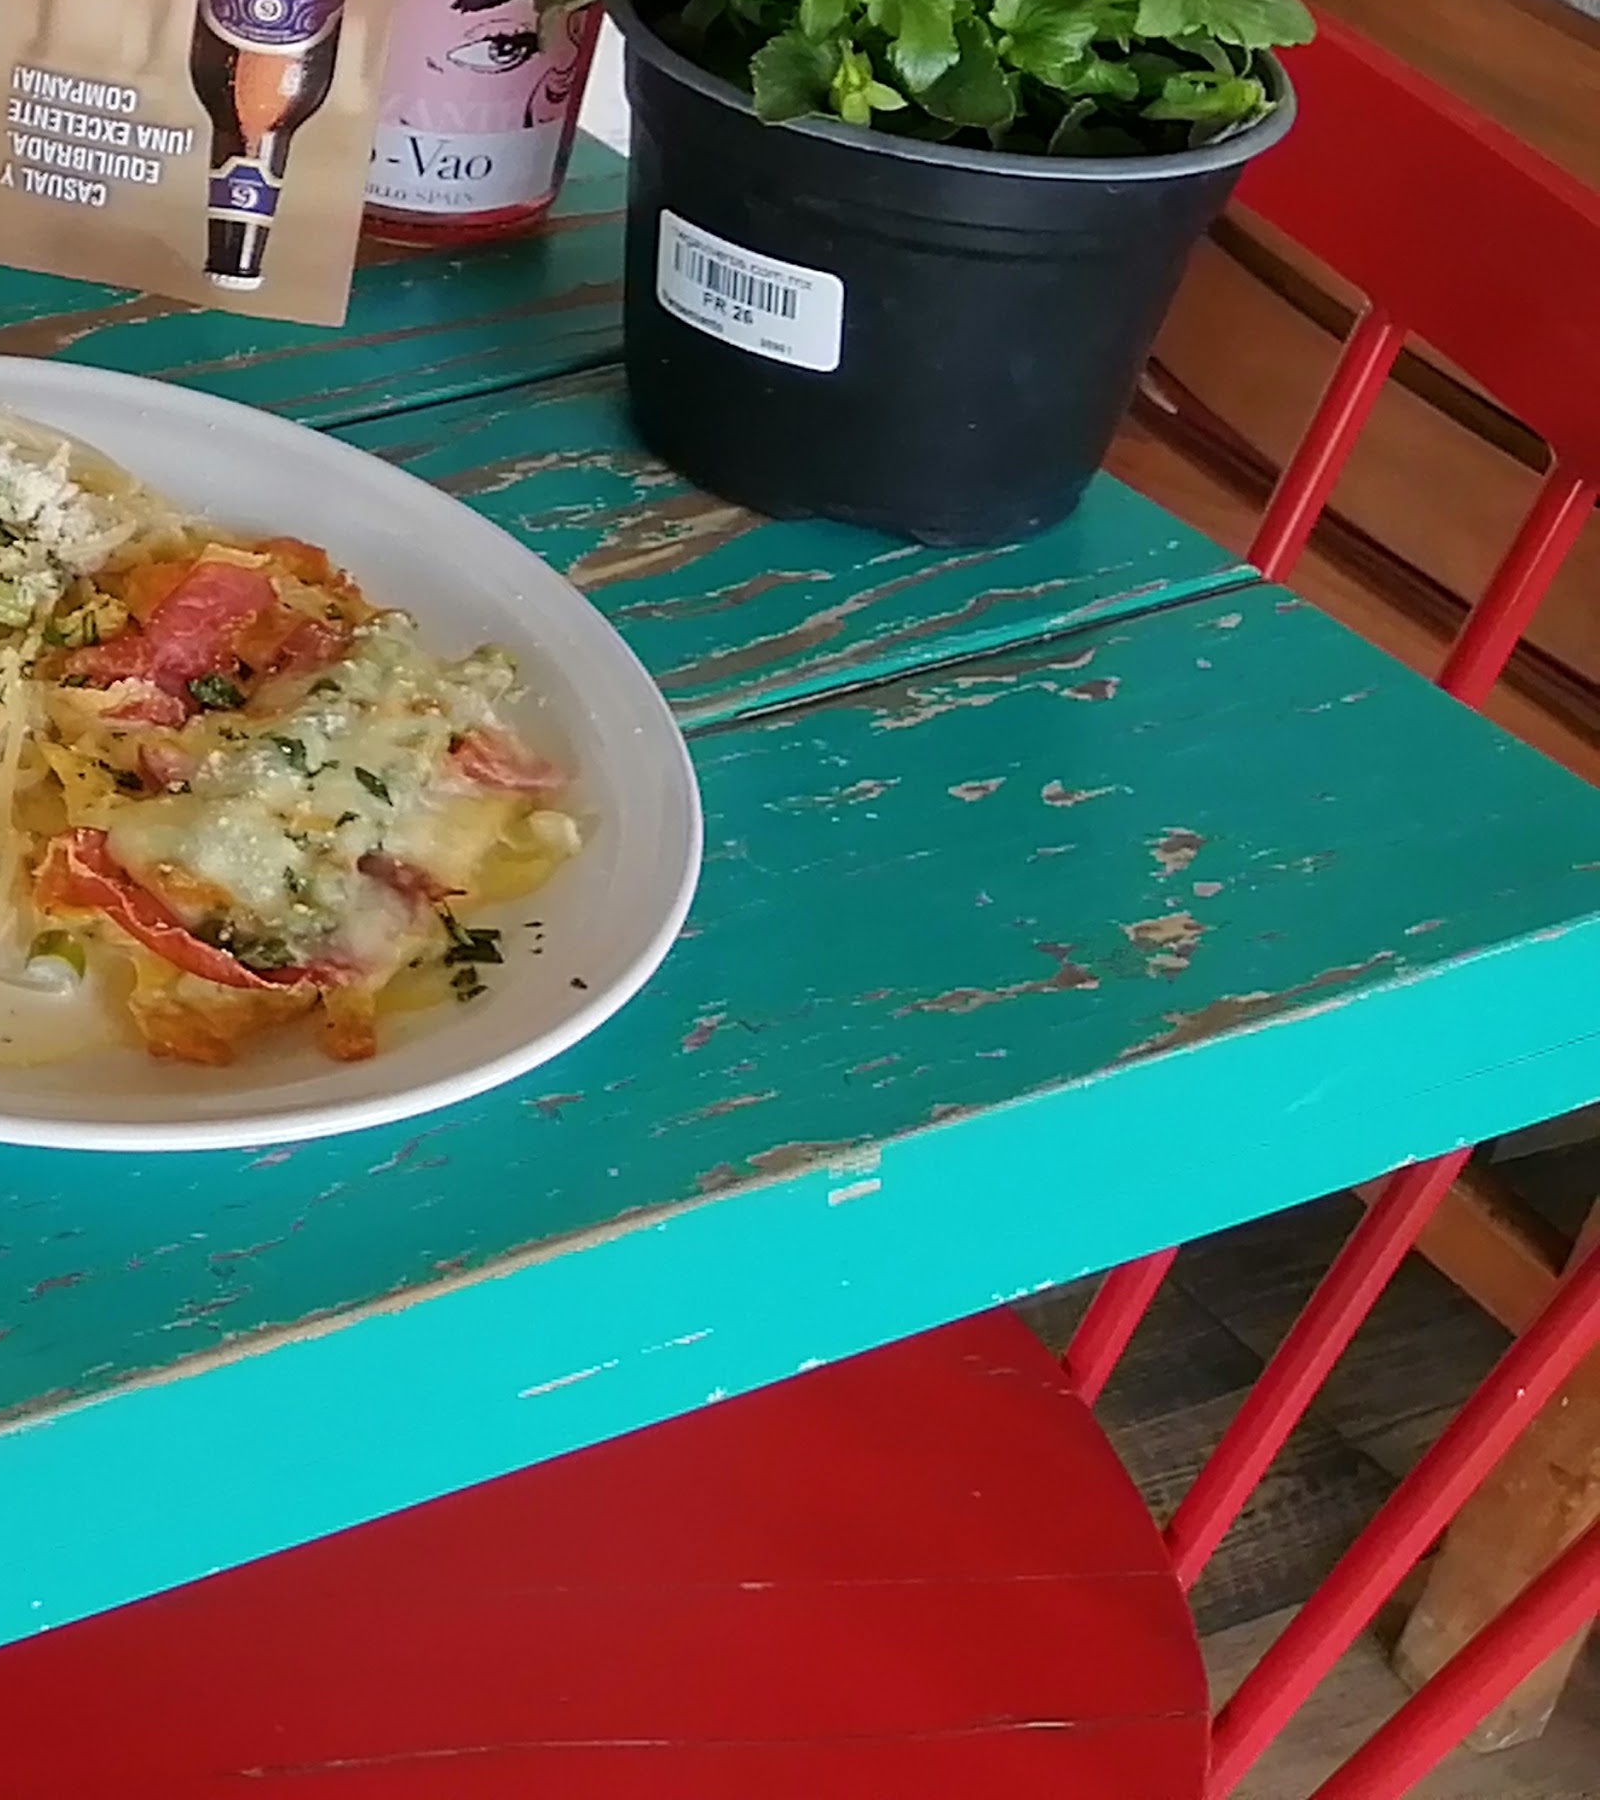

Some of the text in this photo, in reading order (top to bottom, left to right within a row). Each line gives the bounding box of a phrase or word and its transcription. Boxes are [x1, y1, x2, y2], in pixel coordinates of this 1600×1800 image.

[7, 97, 131, 146] EXCELENTE
[7, 130, 160, 185] EQUILIBRADA.
[0, 162, 107, 207] CASUAL Y
